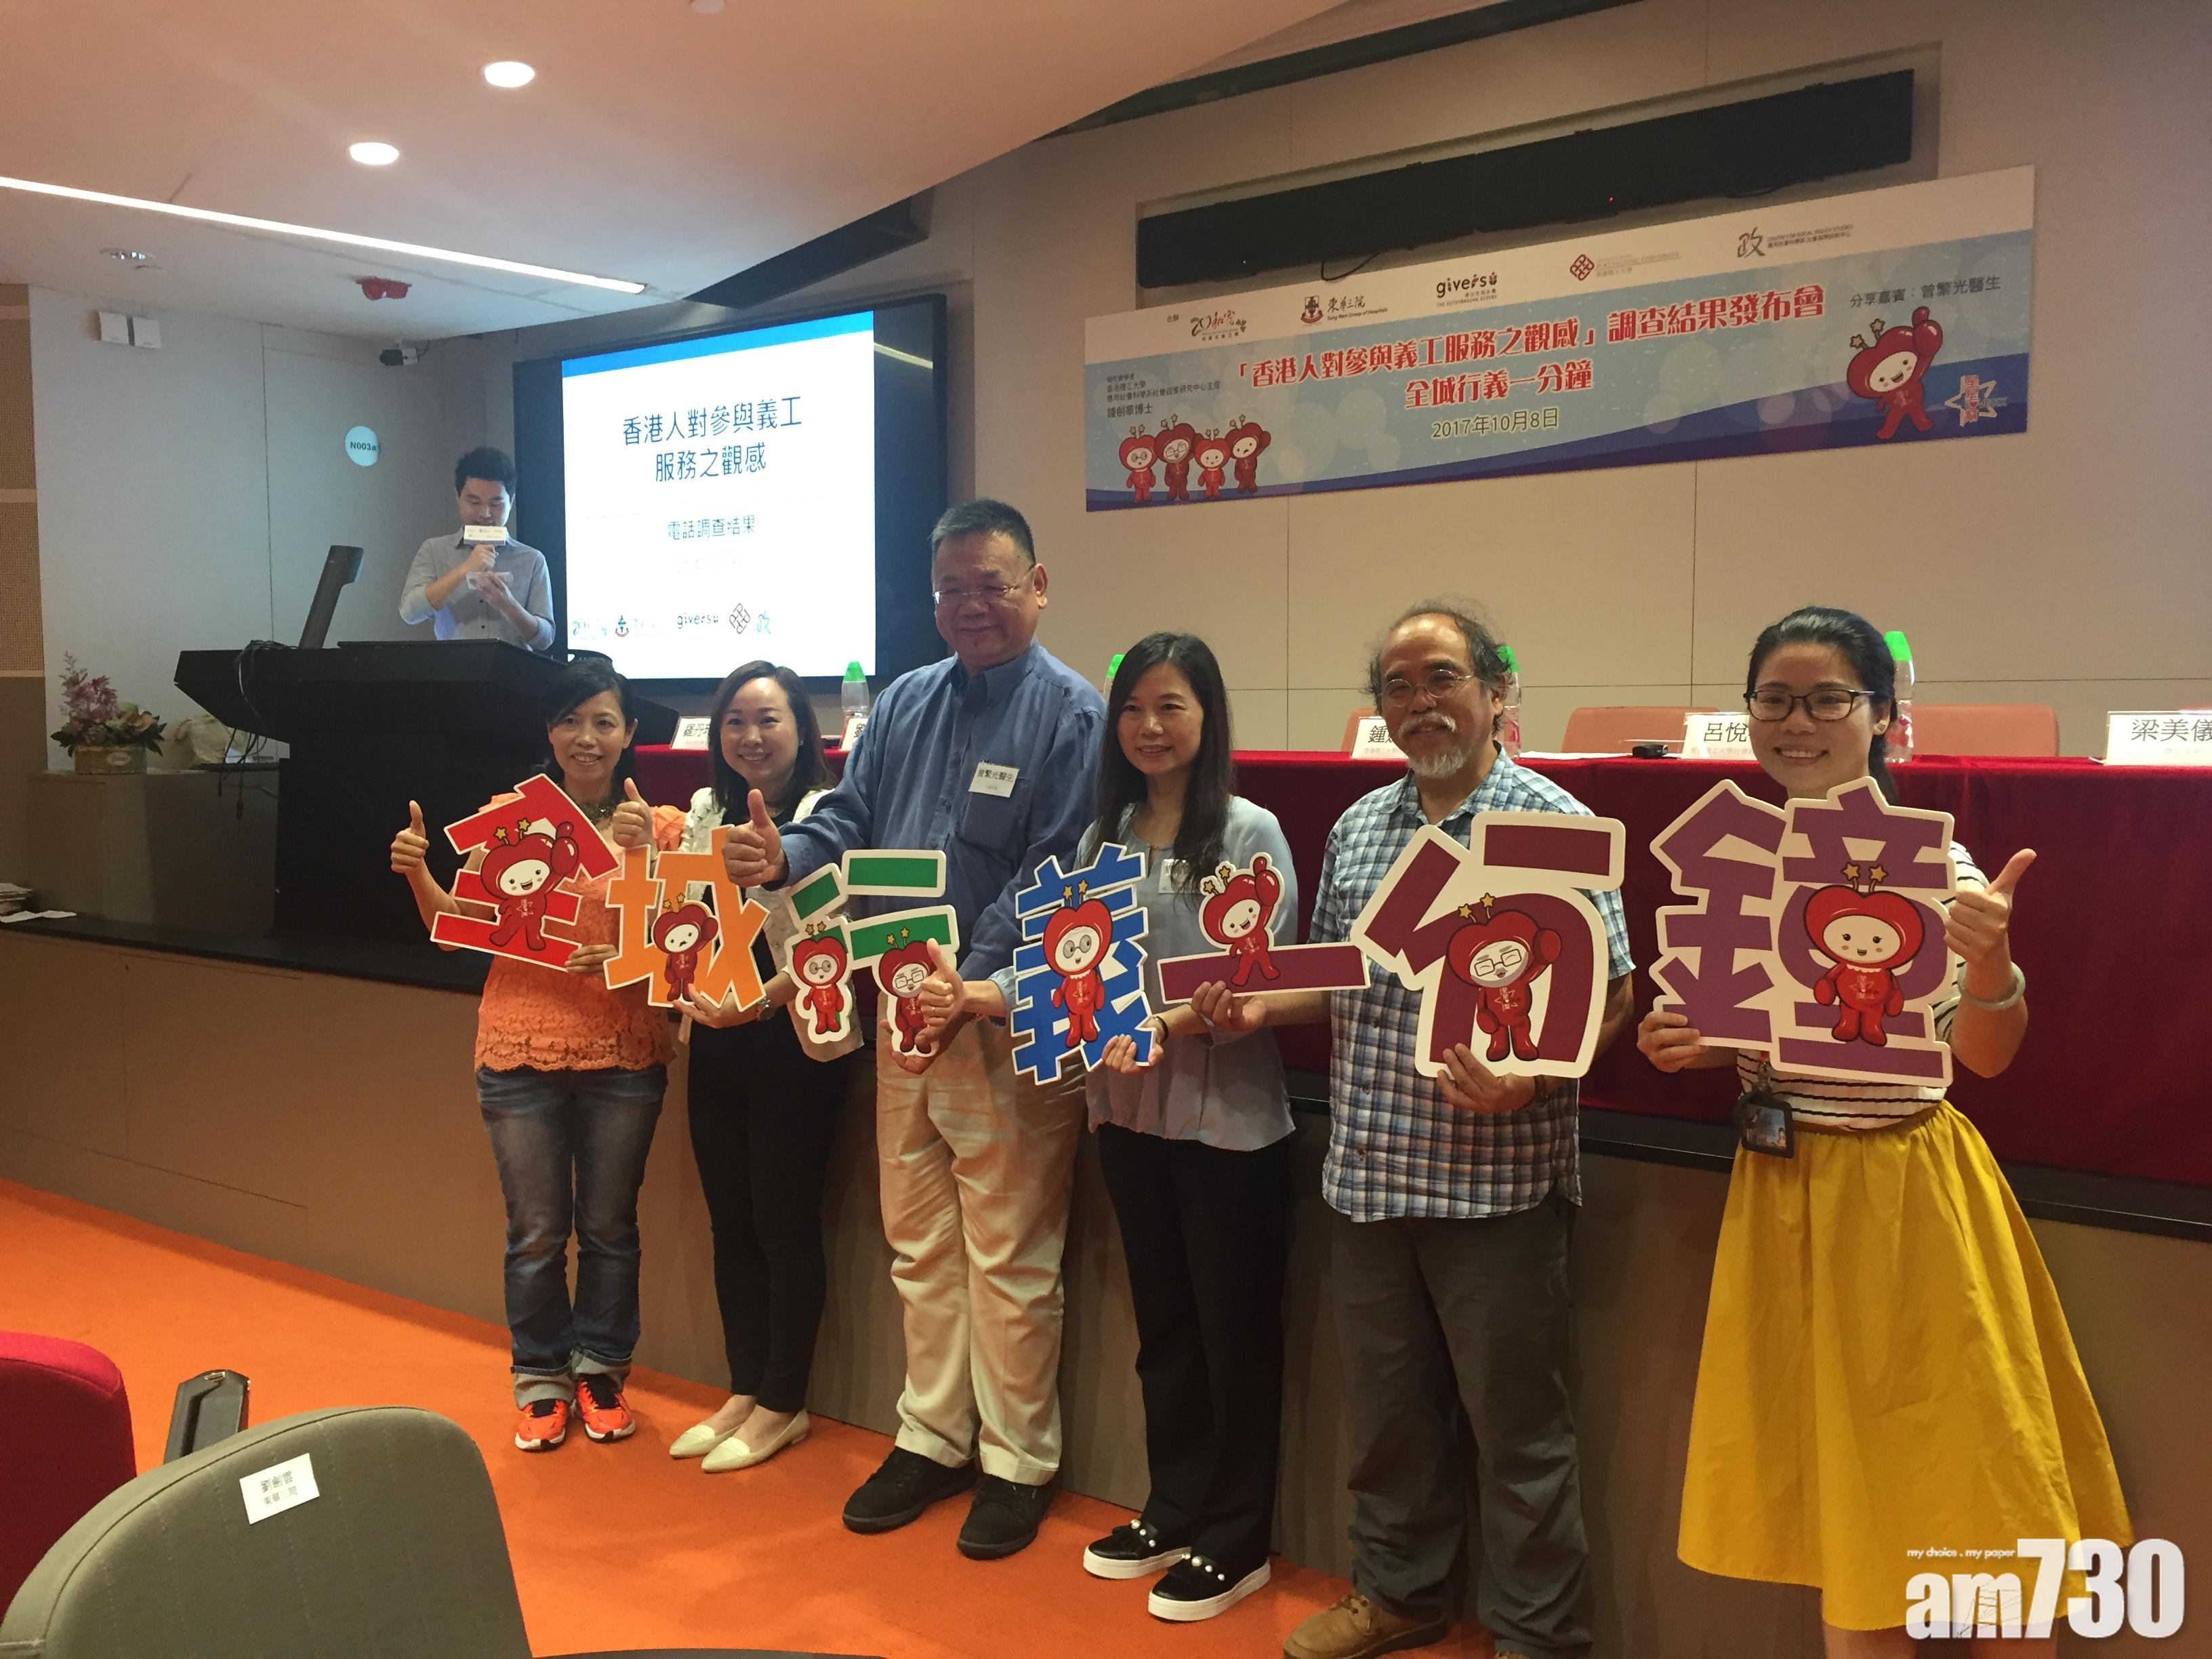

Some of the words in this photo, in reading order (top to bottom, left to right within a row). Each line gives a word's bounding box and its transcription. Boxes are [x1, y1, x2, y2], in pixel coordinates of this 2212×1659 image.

[1406, 359, 1593, 408] 全城行義一分鐘
[623, 396, 802, 446] 香港人對參與義工
[1431, 407, 1559, 438] 2017年10月8日
[350, 441, 376, 451] N003a
[655, 442, 766, 483] 服務之觀感
[668, 514, 756, 540] 電話調查結果
[1368, 724, 1393, 743] 鍾
[1704, 722, 1750, 743] 呂悅
[2131, 718, 2212, 742] 梁美儀
